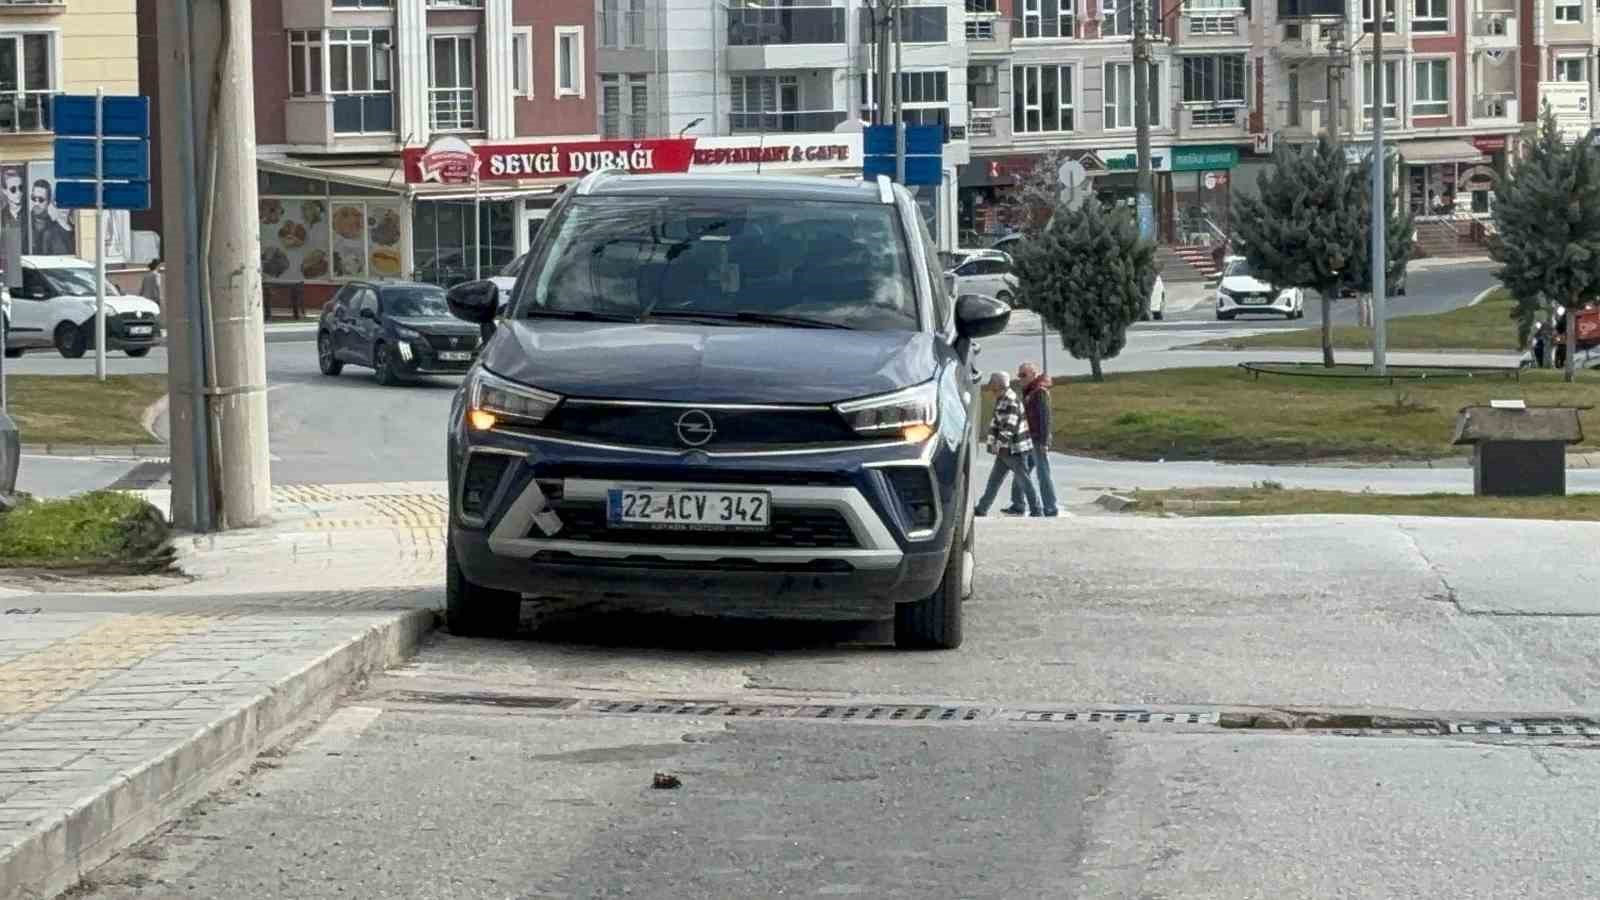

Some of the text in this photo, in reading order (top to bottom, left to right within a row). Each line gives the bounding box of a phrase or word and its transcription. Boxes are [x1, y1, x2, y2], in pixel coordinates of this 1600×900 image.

[490, 146, 559, 176] SEVGİ
[568, 143, 654, 172] DURAĞI
[693, 146, 791, 165] RESTAURANT
[792, 145, 804, 162] &
[624, 494, 764, 522] 22 ACV 342
